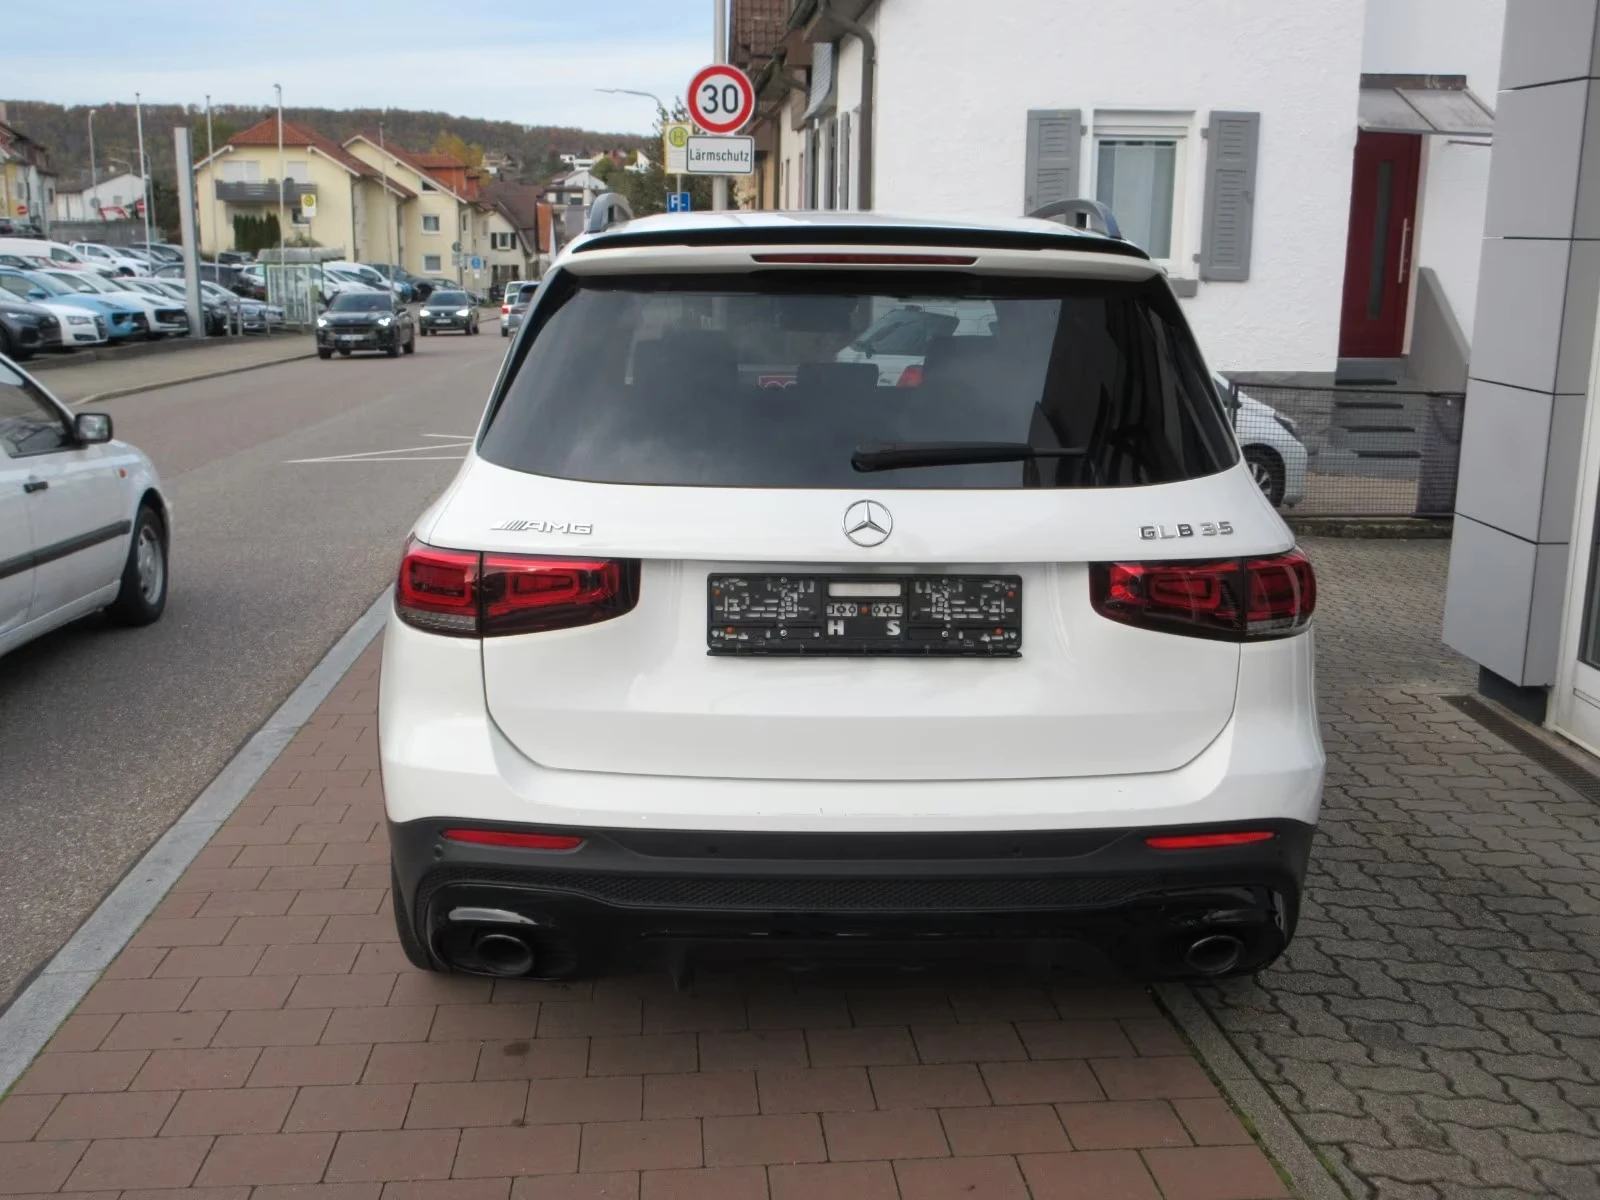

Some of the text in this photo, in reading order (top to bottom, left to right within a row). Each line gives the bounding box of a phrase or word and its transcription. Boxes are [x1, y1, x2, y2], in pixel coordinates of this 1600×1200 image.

[702, 84, 739, 114] 30
[673, 130, 684, 142] H
[689, 148, 750, 162] Lärmschutz
[520, 520, 593, 535] AMG
[1138, 521, 1234, 540] GLB 35
[827, 620, 901, 635] H S
